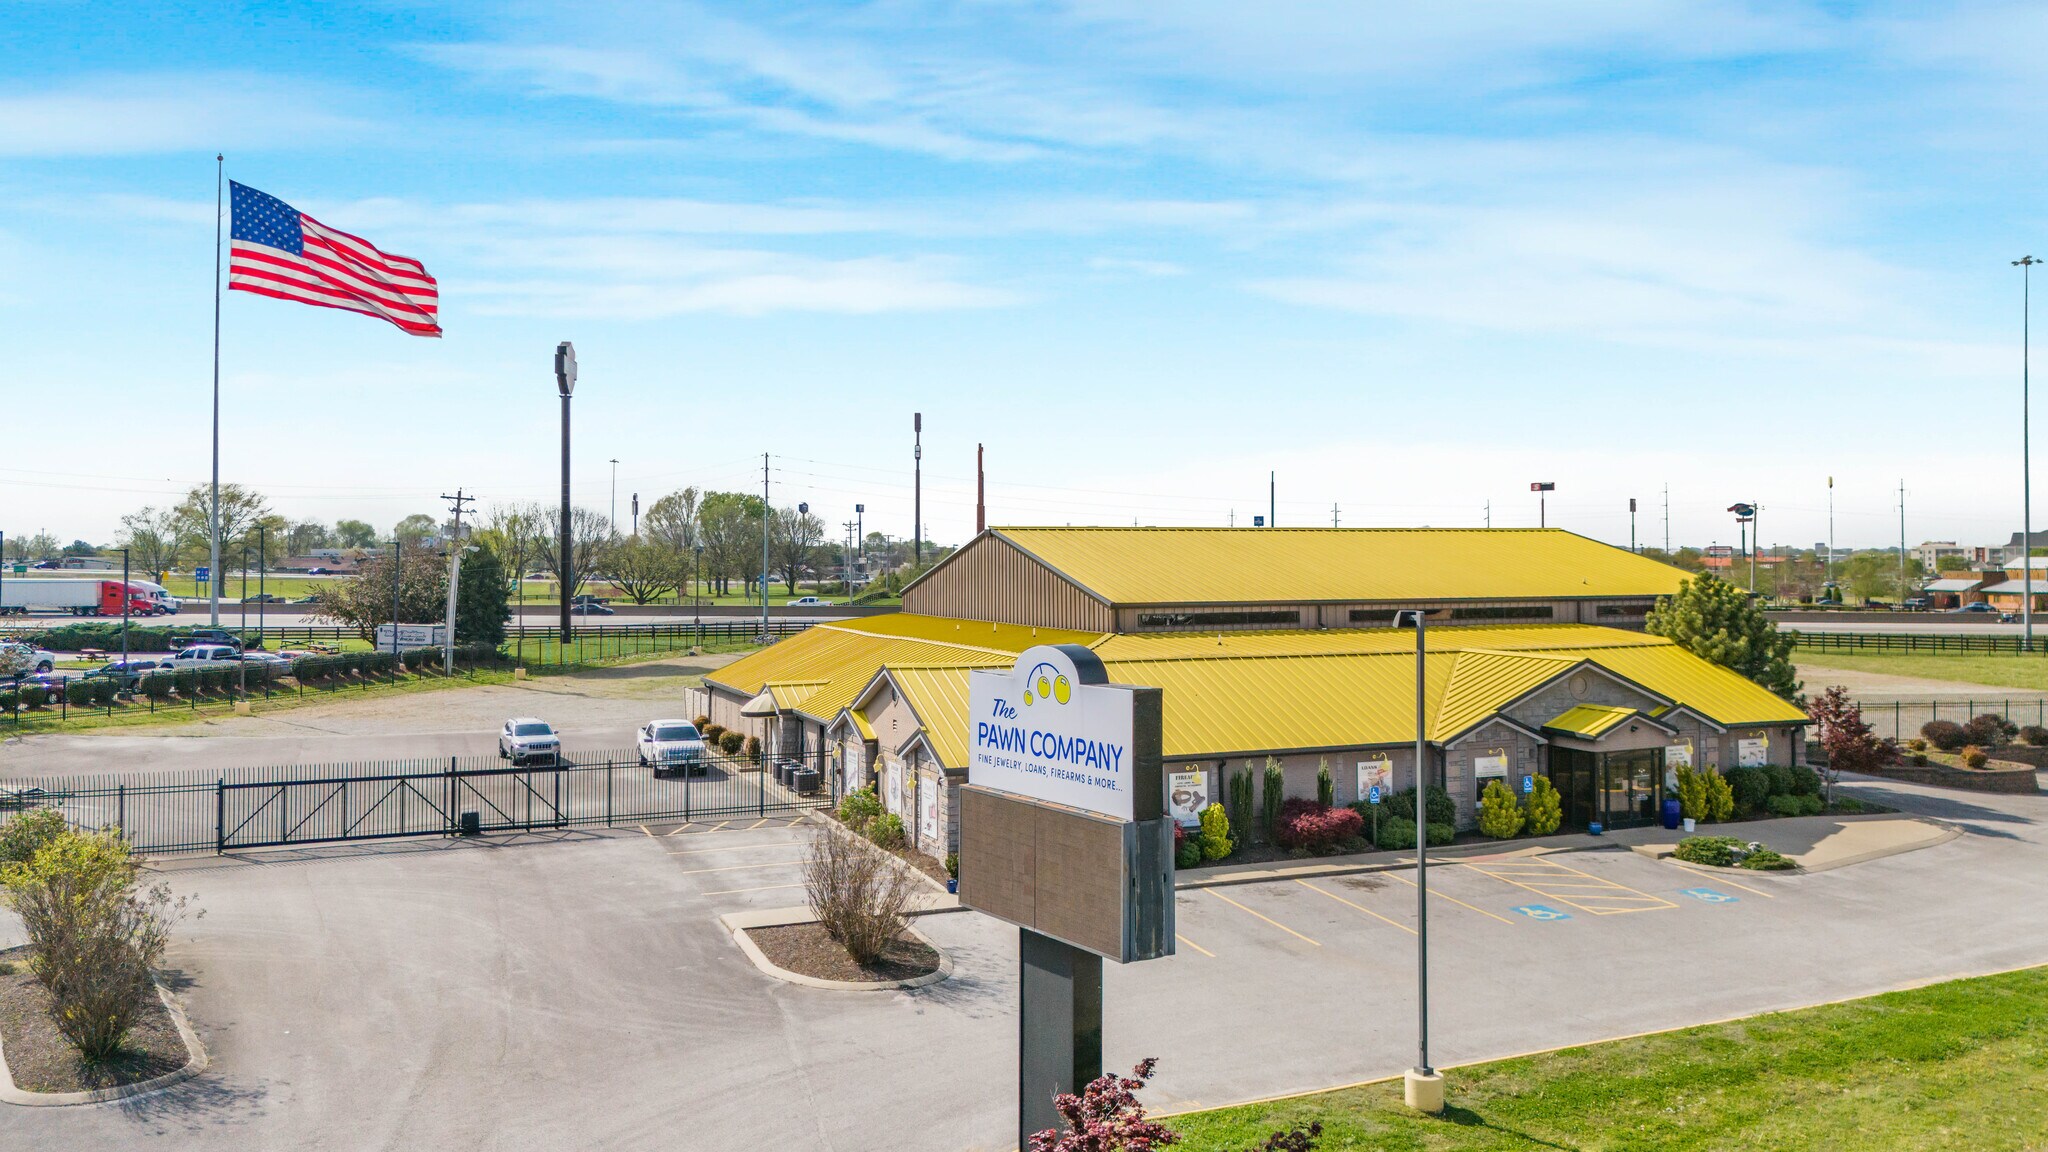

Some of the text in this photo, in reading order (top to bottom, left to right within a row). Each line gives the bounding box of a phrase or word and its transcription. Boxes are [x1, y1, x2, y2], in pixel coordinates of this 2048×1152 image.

[992, 698, 1018, 720] The
[978, 722, 1123, 773] PAWN COMPANY
[978, 753, 1123, 792] FINE JEWELRY, LOANS, FIREARMS & MORE...
